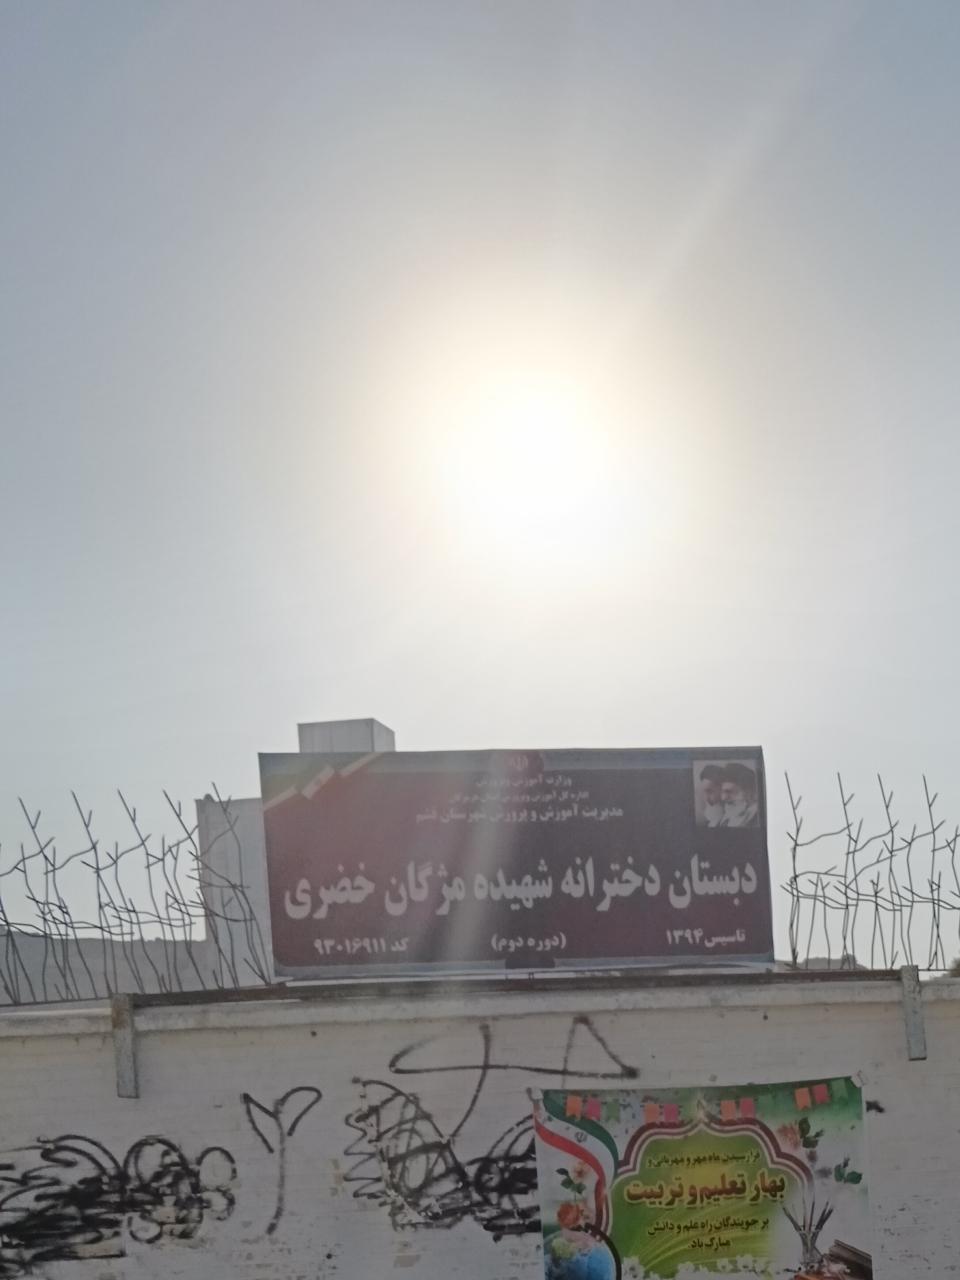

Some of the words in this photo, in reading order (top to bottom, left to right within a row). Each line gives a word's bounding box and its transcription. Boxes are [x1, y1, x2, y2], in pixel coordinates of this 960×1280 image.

[539, 802, 579, 822] آموزش
[581, 806, 624, 821] مدیریت
[284, 861, 376, 920] خضری
[384, 859, 466, 916] مژگان
[473, 858, 553, 911] شهیده
[560, 855, 661, 912] دخترانه
[668, 852, 757, 910] دبستان
[390, 937, 409, 952] کد
[704, 928, 746, 948] تاسیس
[625, 1176, 684, 1207] تربیت
[686, 1183, 698, 1207] و
[698, 1172, 747, 1206] تعلیم
[748, 1171, 787, 1203] بهار
[647, 1219, 675, 1236] دانش
[682, 1219, 699, 1233] علم
[704, 1236, 731, 1251] مبارک
